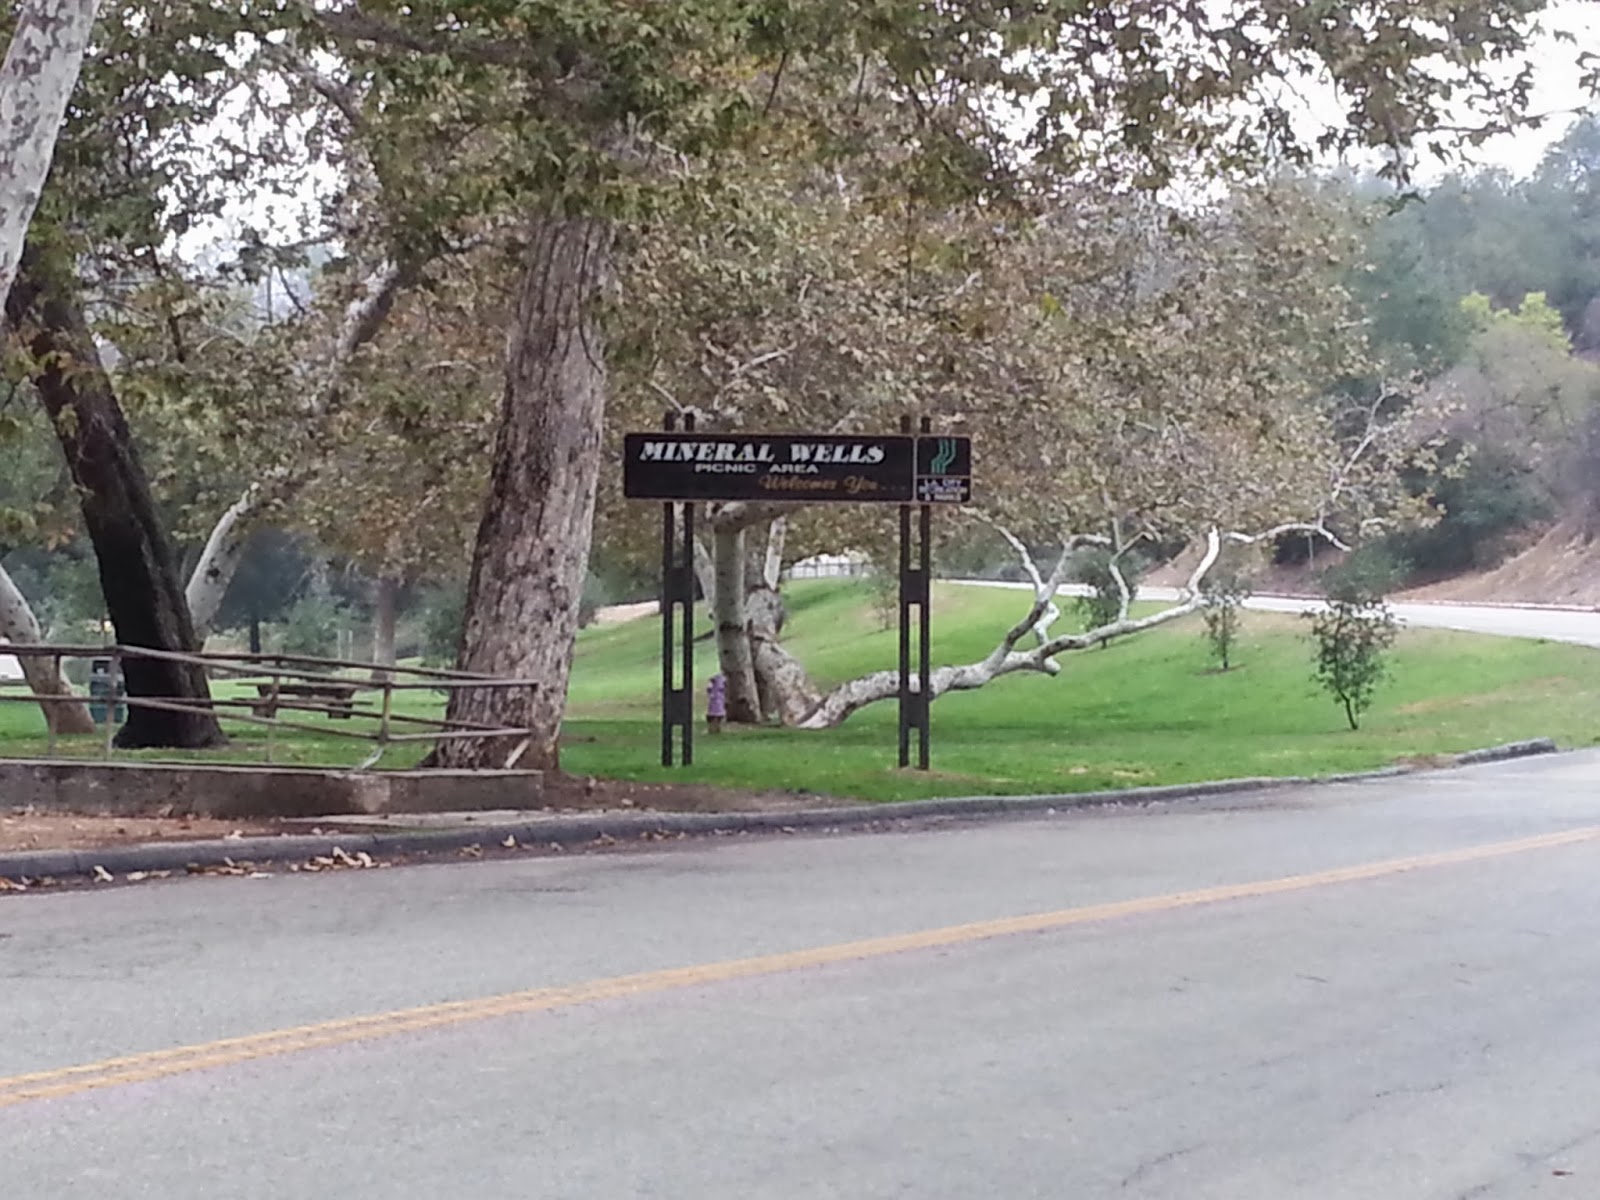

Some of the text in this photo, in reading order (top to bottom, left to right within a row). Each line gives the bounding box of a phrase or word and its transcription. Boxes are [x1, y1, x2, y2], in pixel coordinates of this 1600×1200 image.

[639, 442, 886, 463] MINERAL WELLS
[695, 464, 819, 474] PICNIC AREA
